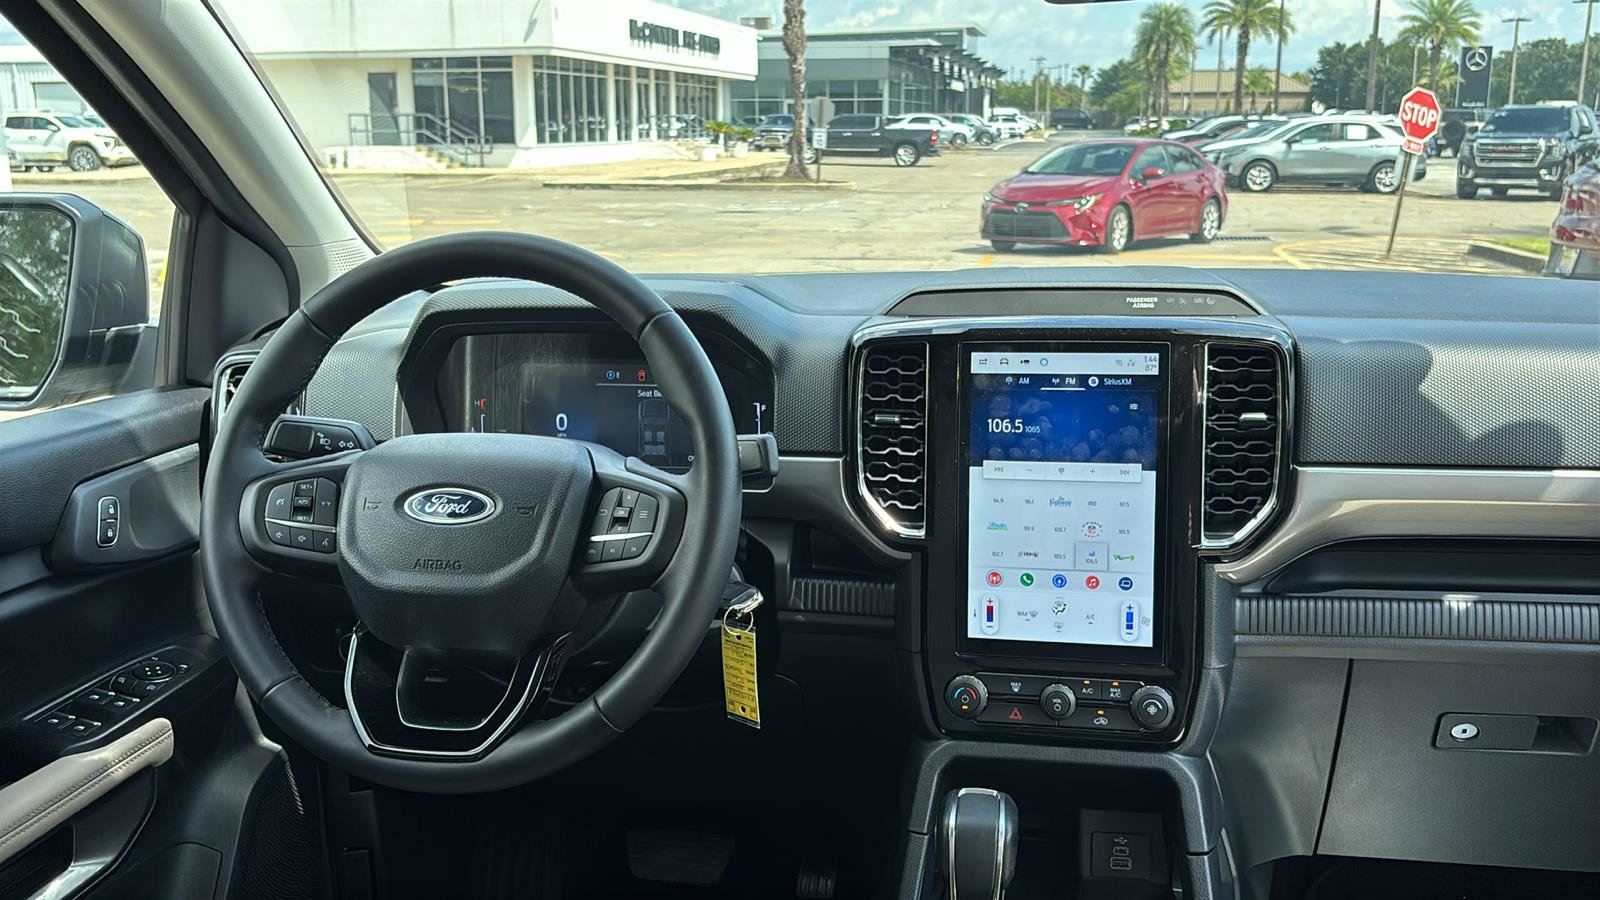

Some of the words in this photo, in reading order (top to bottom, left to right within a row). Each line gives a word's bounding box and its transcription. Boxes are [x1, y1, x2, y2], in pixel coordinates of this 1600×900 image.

[1402, 101, 1438, 129] STOP
[1018, 377, 1030, 385] AM
[1065, 377, 1076, 385] FM
[1103, 377, 1132, 386] SiriusXM
[637, 389, 652, 398] Seat
[555, 412, 569, 432] 0
[987, 418, 1024, 433] 106.5
[1025, 425, 1041, 433] 1065
[424, 494, 472, 515] Ford
[413, 558, 463, 571] AIRBAG
[1081, 687, 1094, 695] A/C
